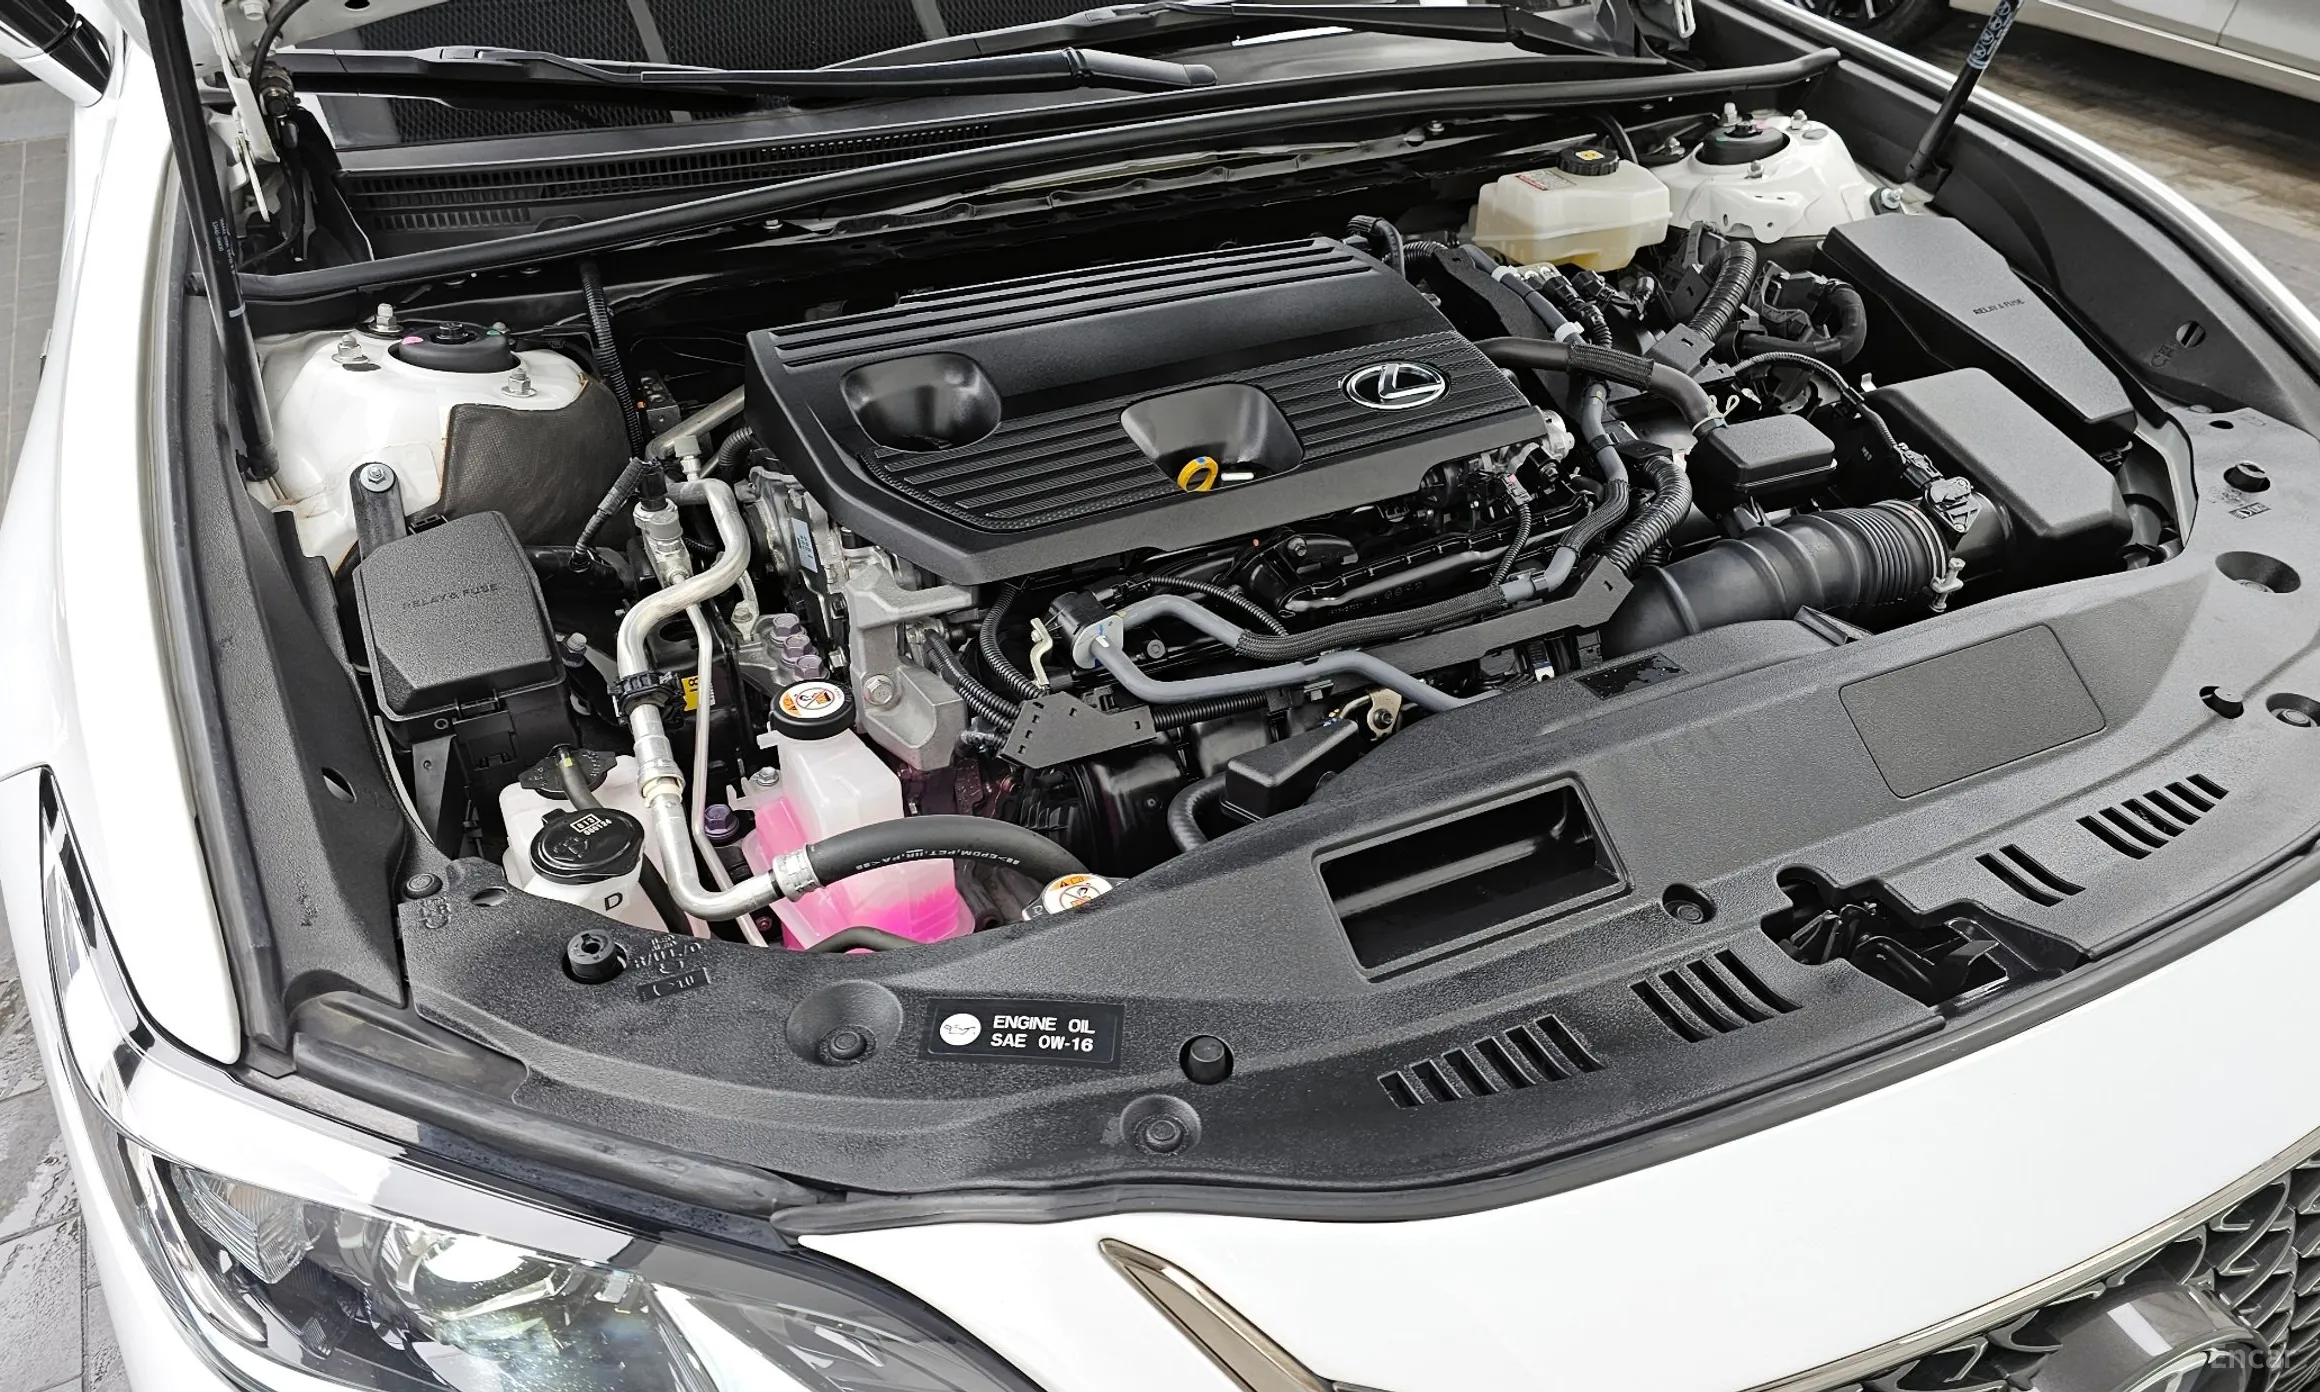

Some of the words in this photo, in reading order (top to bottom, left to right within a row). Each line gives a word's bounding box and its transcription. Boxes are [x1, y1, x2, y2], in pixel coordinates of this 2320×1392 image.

[604, 892, 624, 912] D
[993, 1015, 1057, 1031] ENGINE
[1068, 1018, 1096, 1035] OIL
[990, 1033, 1028, 1048] SAE
[1038, 1034, 1094, 1053] 0W-16
